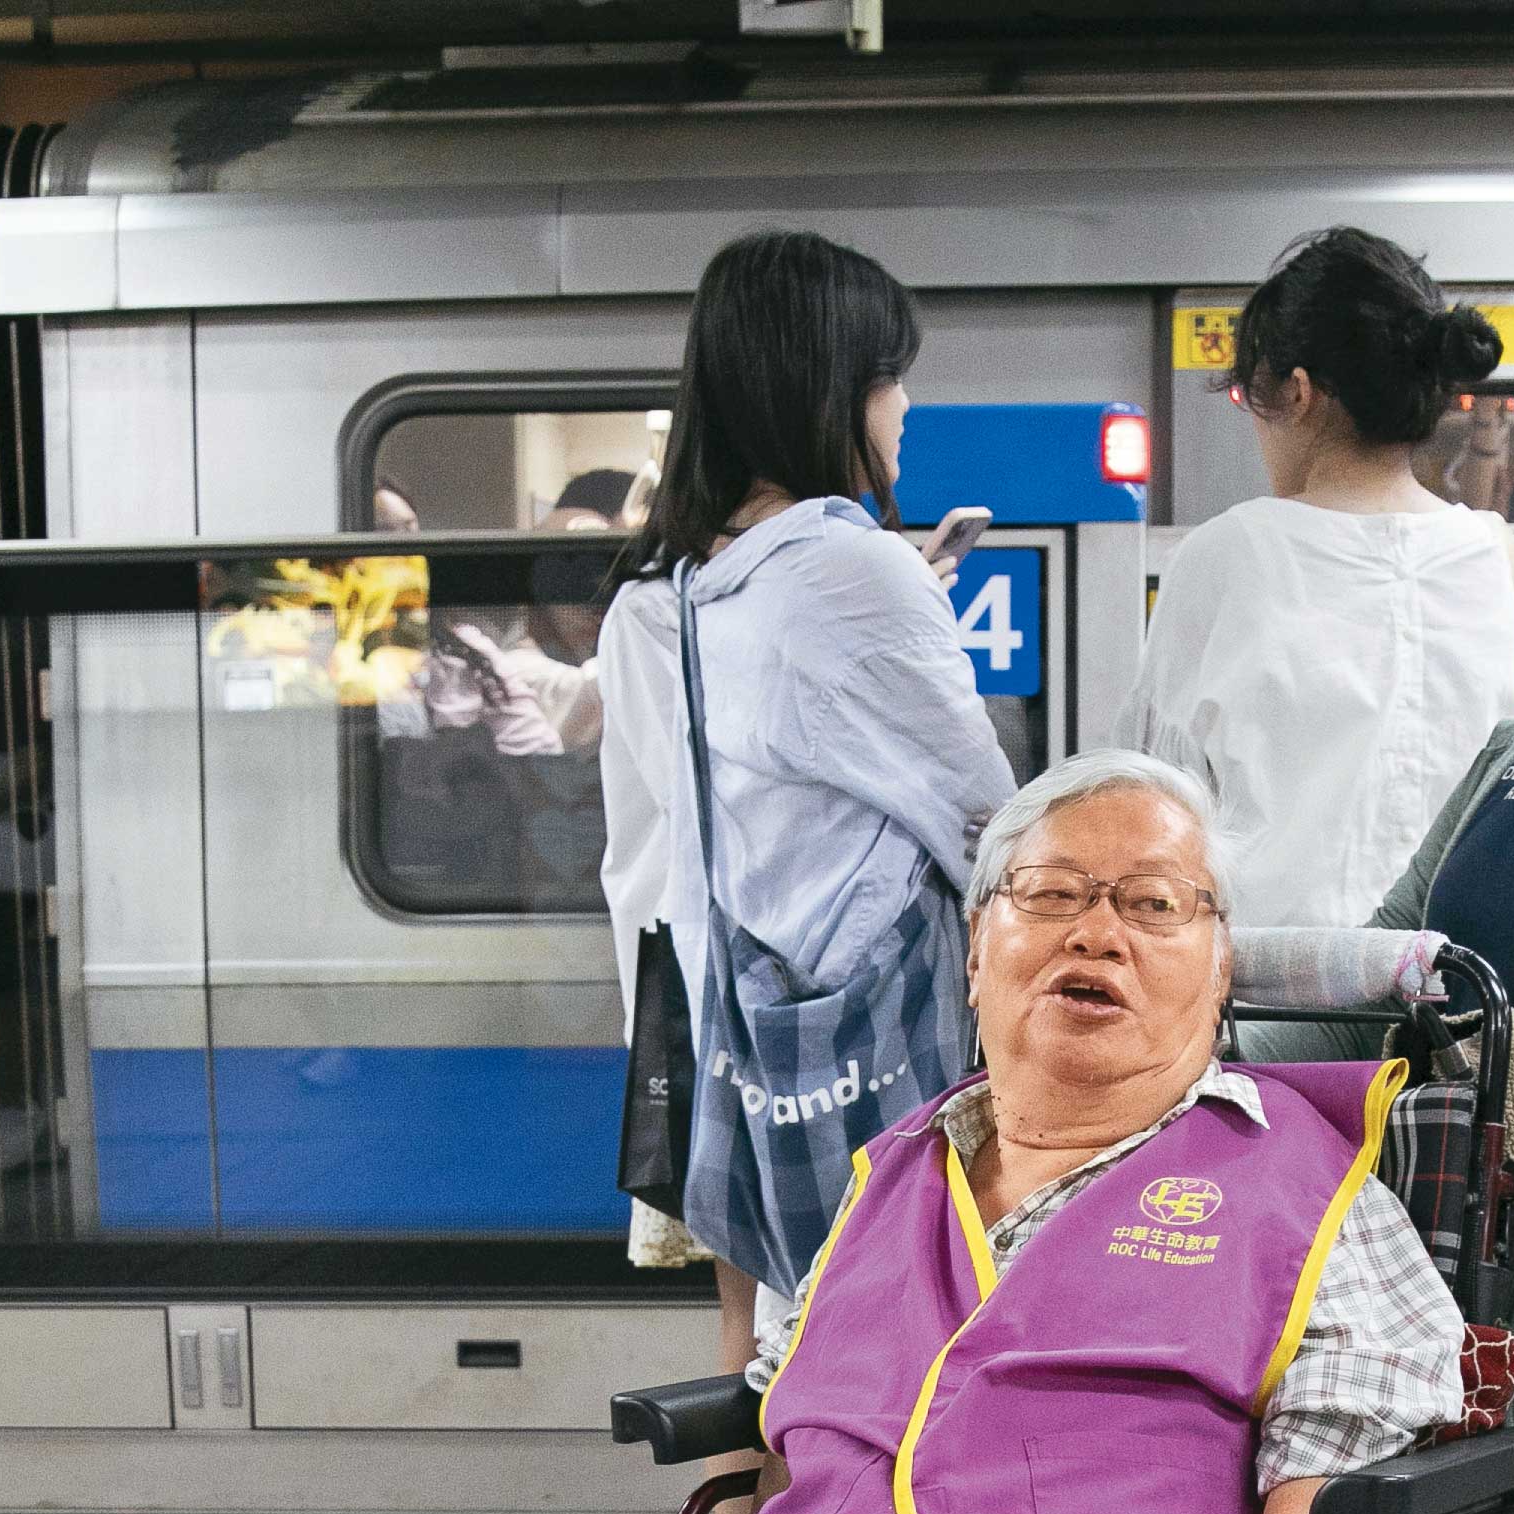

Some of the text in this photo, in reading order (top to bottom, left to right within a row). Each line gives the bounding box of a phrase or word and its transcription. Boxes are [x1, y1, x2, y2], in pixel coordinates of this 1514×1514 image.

[956, 573, 1023, 671] 4
[1111, 1225, 1222, 1252] 中華生命教育
[1106, 1241, 1216, 1266] ROC Life Education
